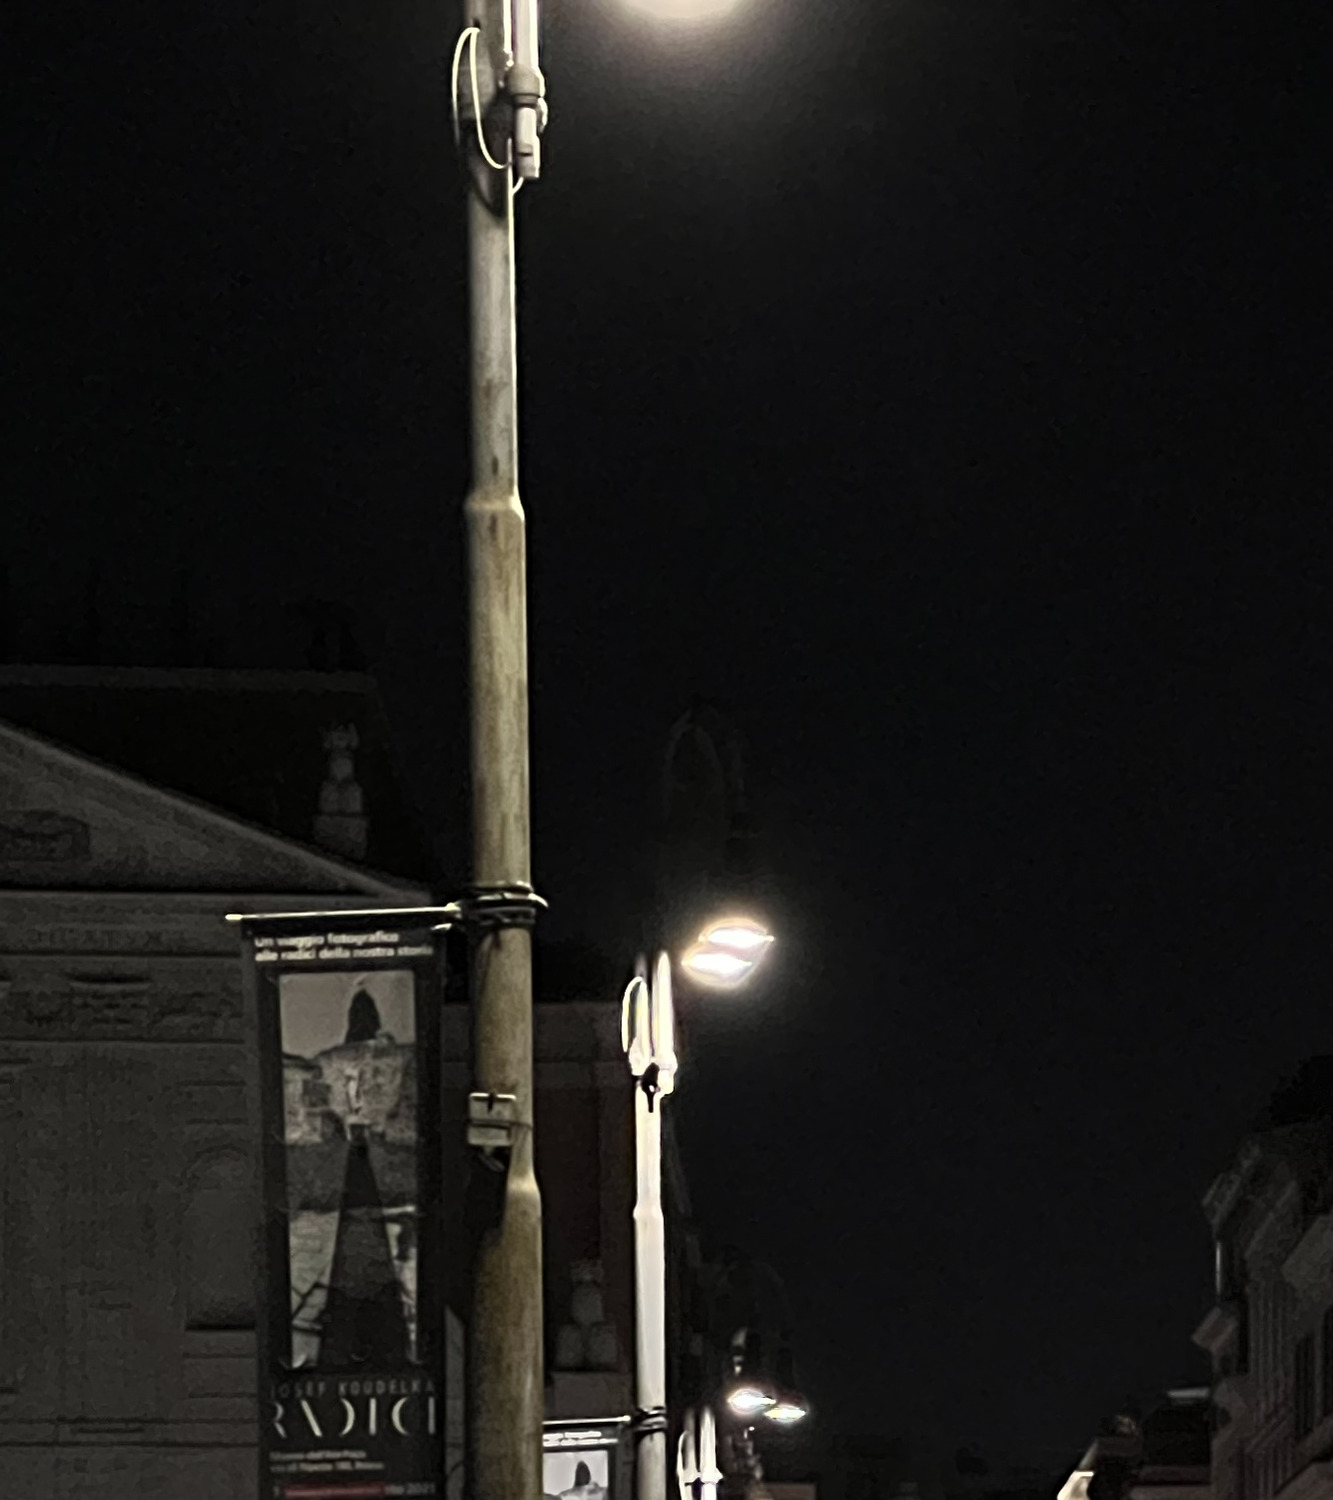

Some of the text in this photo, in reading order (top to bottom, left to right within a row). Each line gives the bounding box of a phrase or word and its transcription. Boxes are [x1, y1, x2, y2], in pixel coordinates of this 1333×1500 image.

[327, 931, 399, 946] fotografico
[319, 948, 350, 959] della
[270, 1379, 435, 1398] JOSEF KOUDELKA
[272, 1396, 436, 1438] RADICI
